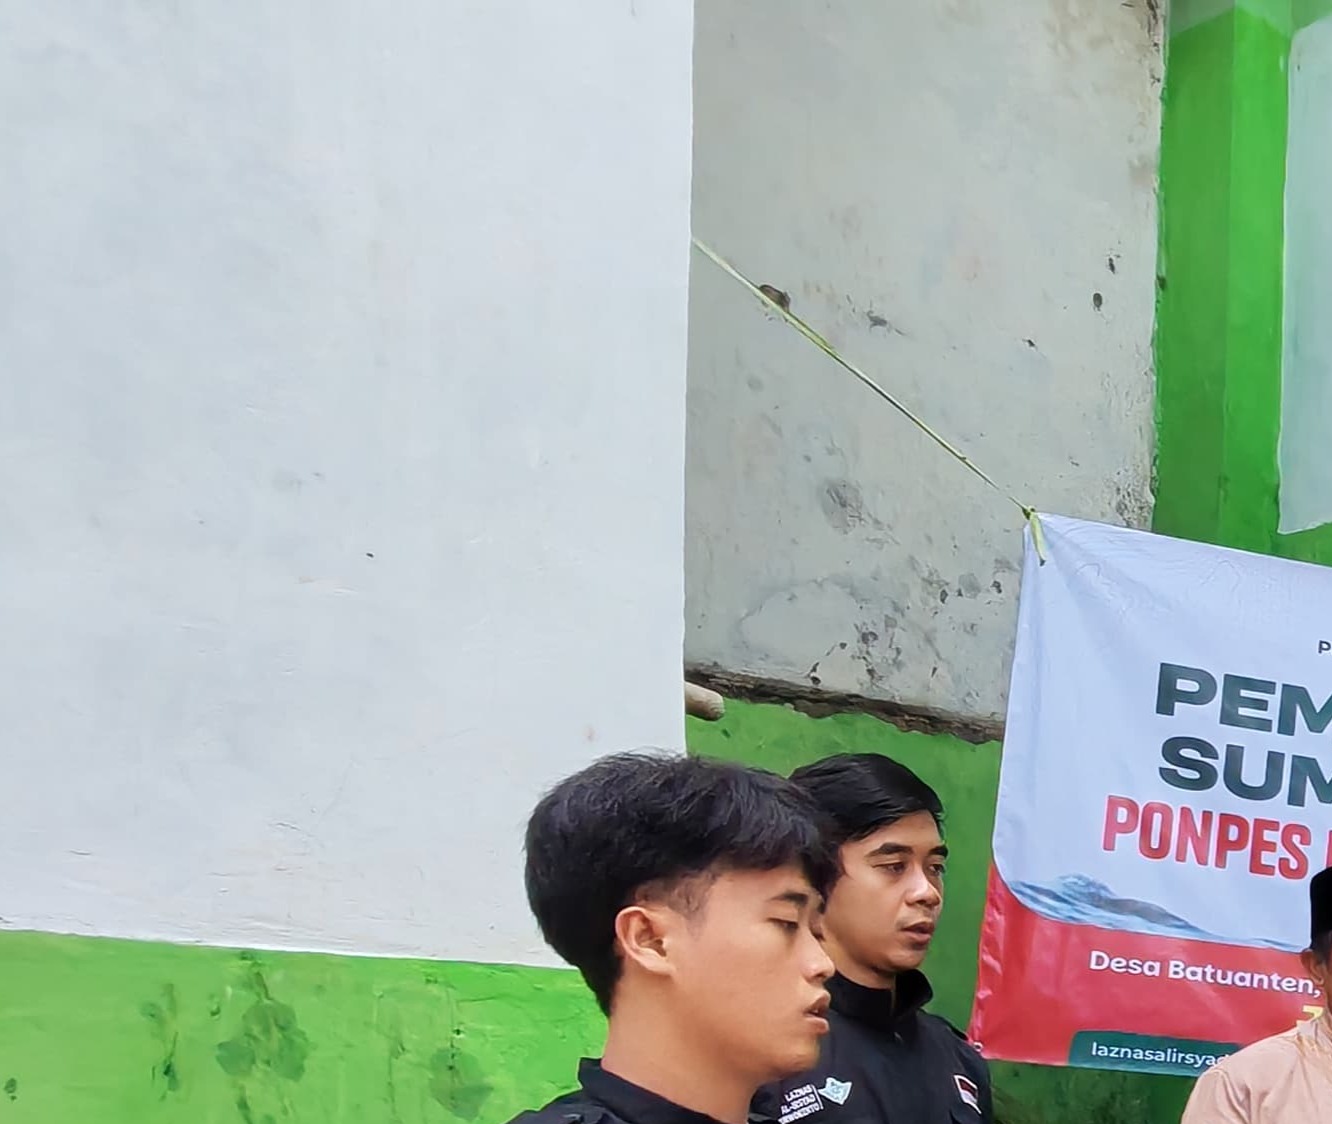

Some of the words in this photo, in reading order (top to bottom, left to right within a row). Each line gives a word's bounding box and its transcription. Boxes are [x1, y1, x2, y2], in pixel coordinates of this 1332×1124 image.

[1103, 795, 1312, 880] PONPES
[1089, 950, 1160, 977] Desa
[1168, 959, 1321, 998] Batuanten,
